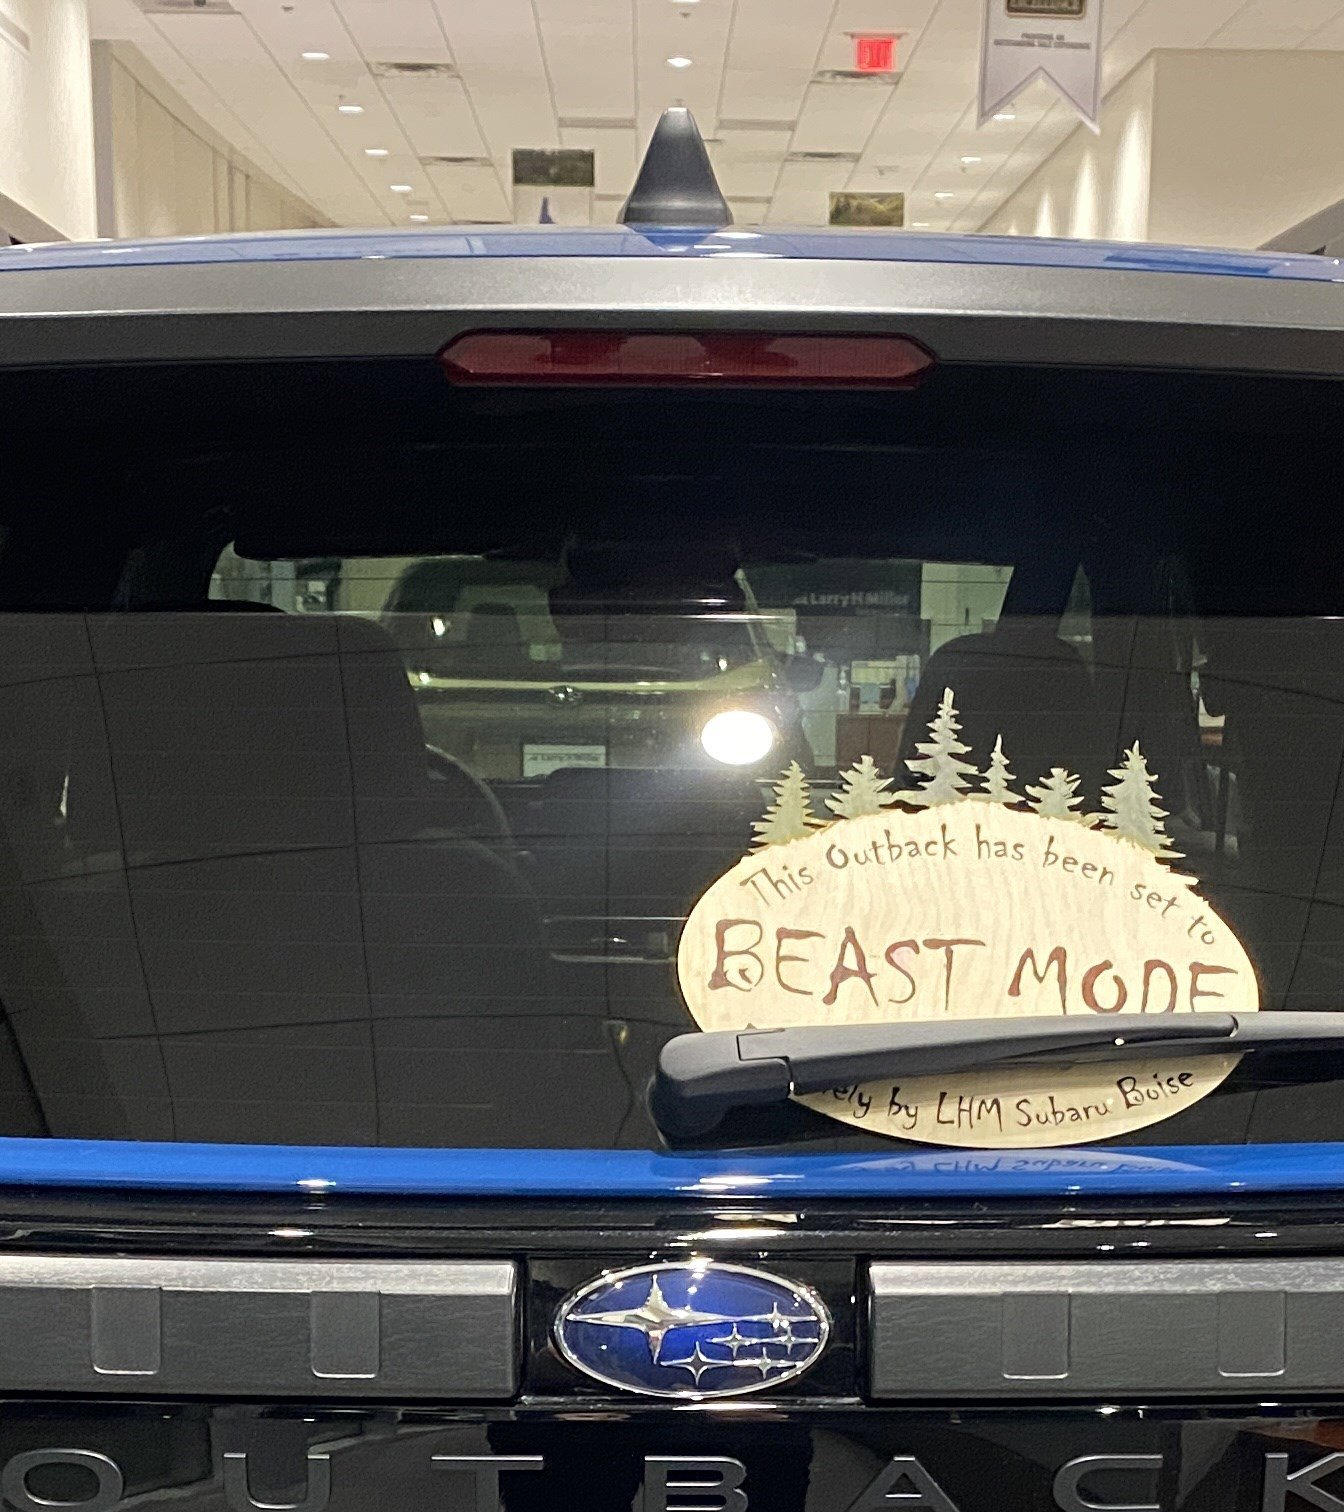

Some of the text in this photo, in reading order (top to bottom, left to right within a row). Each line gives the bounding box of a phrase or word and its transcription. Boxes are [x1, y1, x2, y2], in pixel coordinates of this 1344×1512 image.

[740, 823, 1216, 946] This Outback has been set to
[708, 919, 1239, 1015] BEAST MODE
[887, 1086, 919, 1130] by
[936, 1091, 1003, 1132] LHM
[1016, 1096, 1110, 1128] Subaru
[1117, 1069, 1195, 1110] Boise
